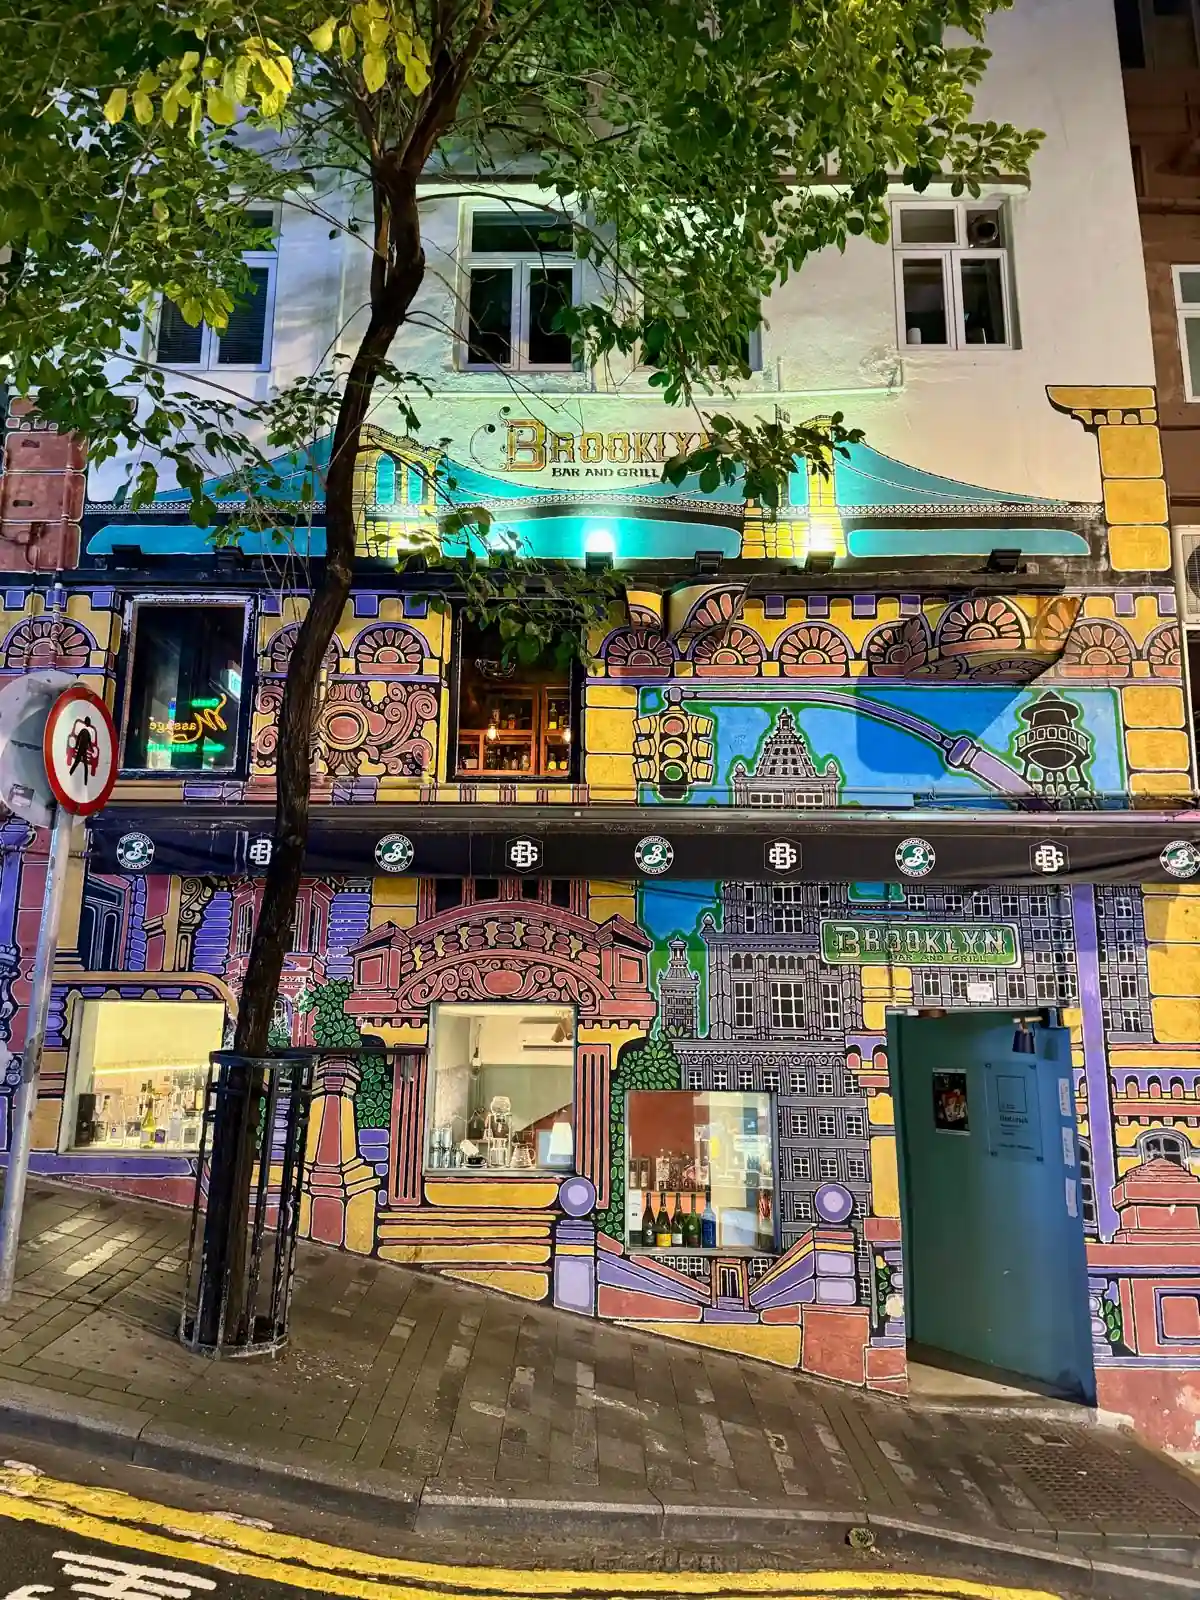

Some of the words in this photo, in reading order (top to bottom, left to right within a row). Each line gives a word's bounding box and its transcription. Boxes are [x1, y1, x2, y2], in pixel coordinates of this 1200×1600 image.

[551, 467, 580, 478] BAR
[584, 468, 614, 478] AND
[616, 468, 661, 479] GRILL
[380, 835, 410, 847] BROOKLYN
[639, 837, 670, 848] BROOKLYN
[900, 839, 931, 850] BROOKLYN
[379, 860, 409, 871] BREWERY
[639, 862, 669, 873] BREWERY
[900, 864, 930, 876] BREWERY
[832, 925, 1007, 959] BROOKLYN
[951, 955, 987, 963] GRILL
